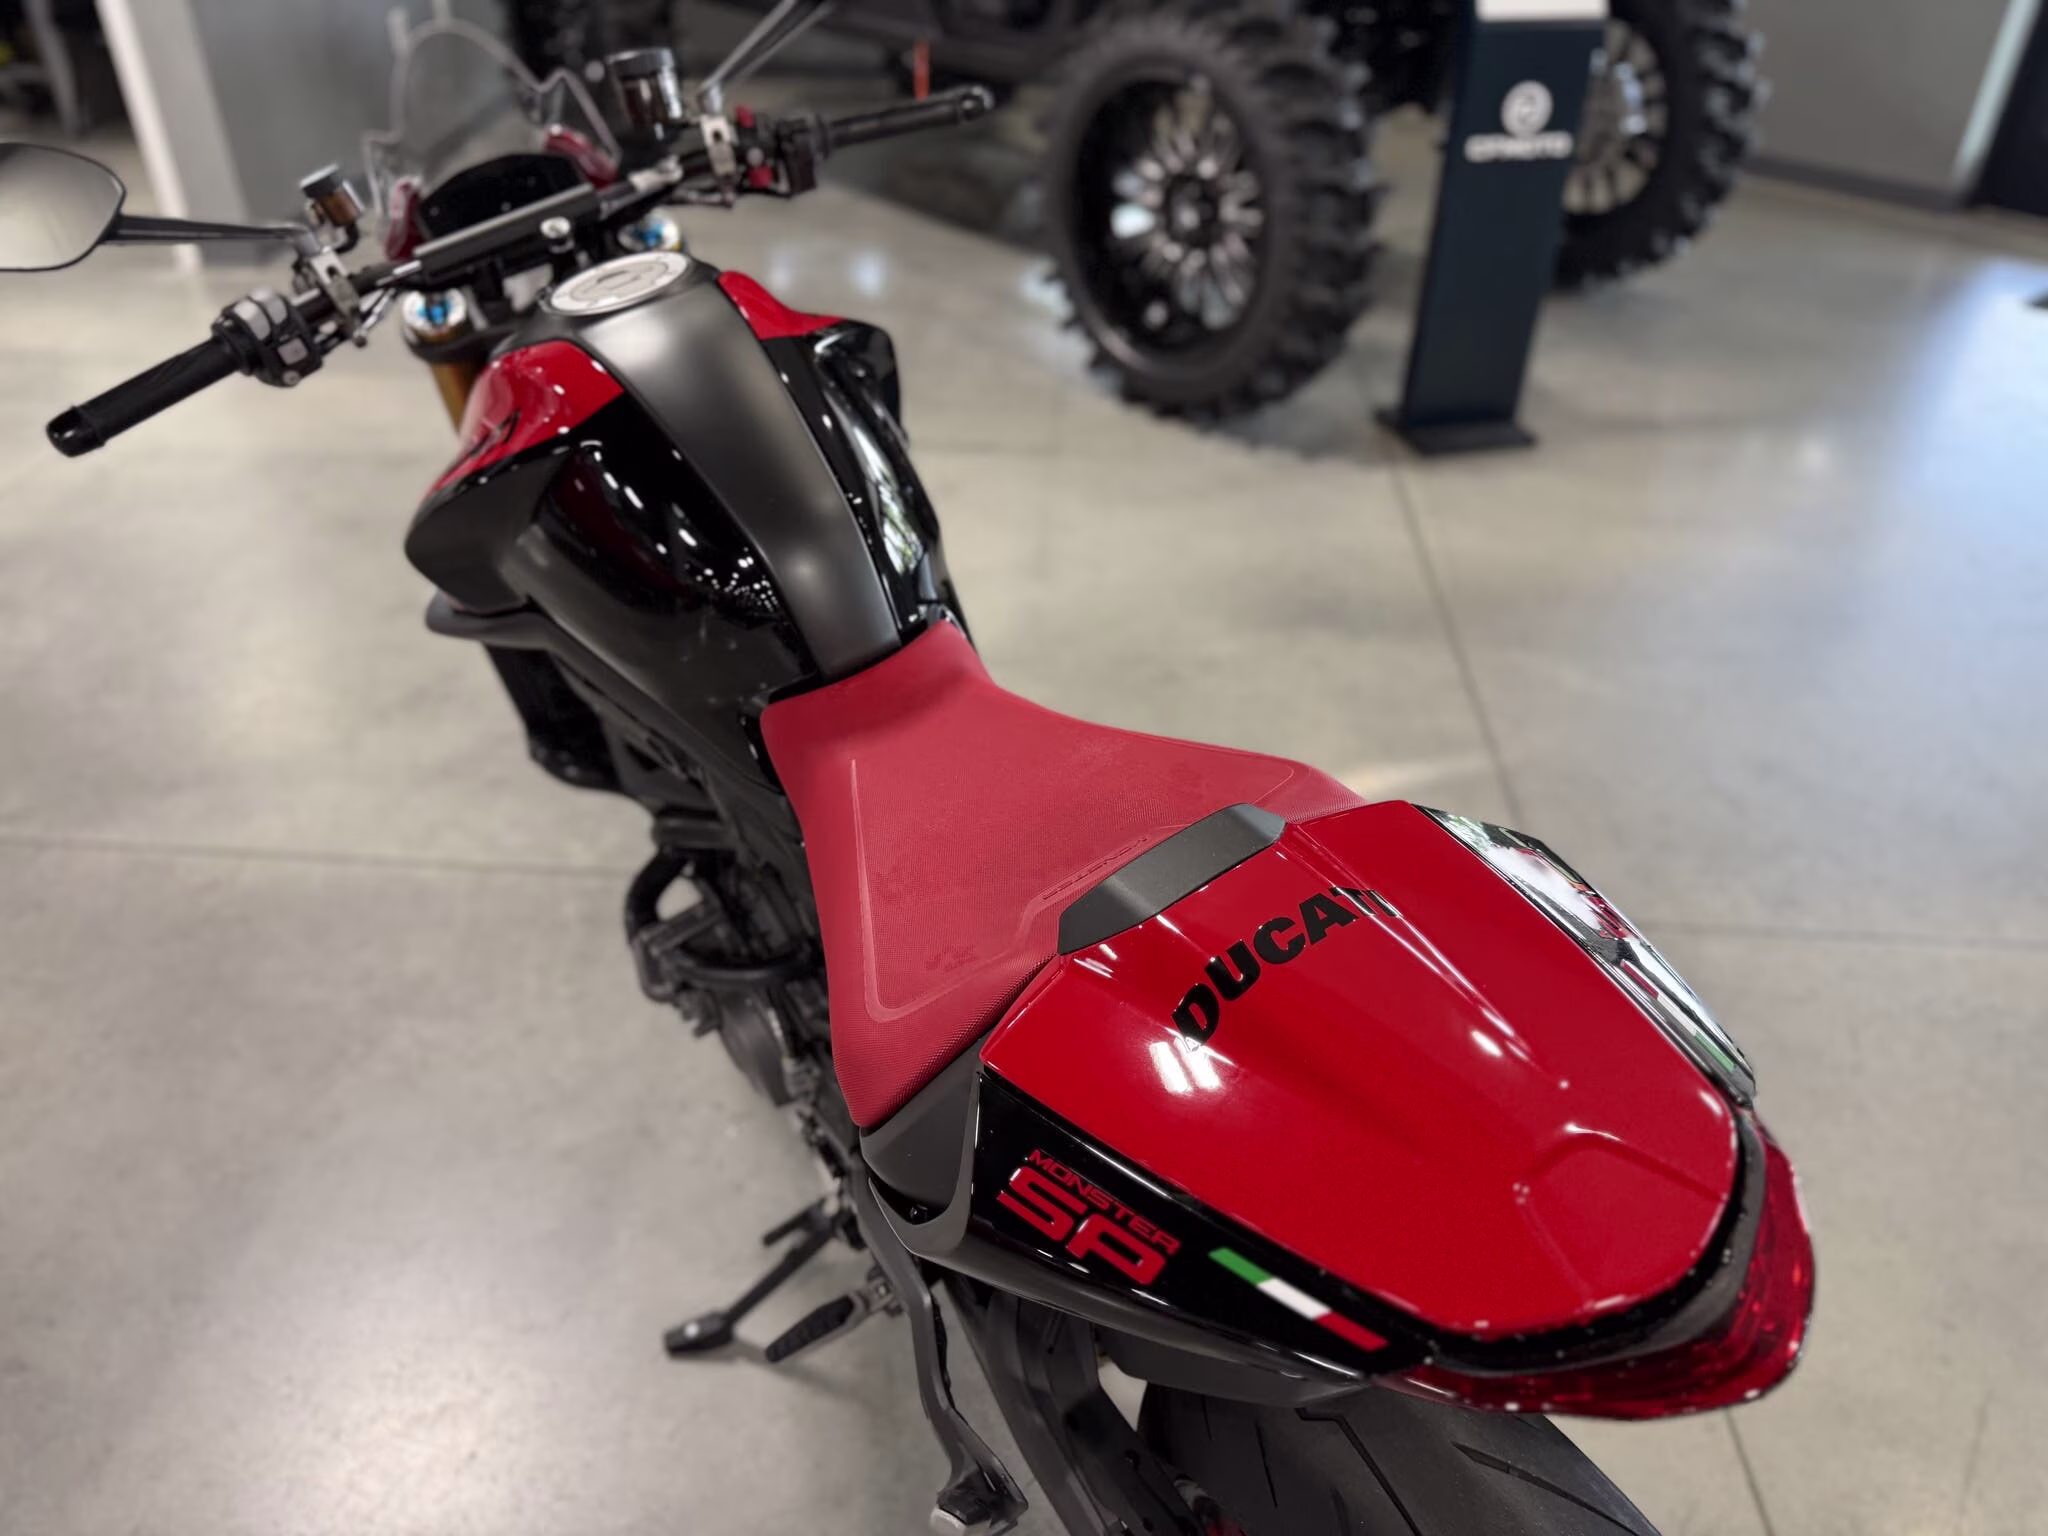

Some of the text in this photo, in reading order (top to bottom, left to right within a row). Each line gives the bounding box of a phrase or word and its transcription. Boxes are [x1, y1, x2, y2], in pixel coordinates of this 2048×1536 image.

[1171, 886, 1402, 1052] DUCATI
[996, 1166, 1167, 1286] SP
[1028, 1149, 1182, 1256] MONSTER
